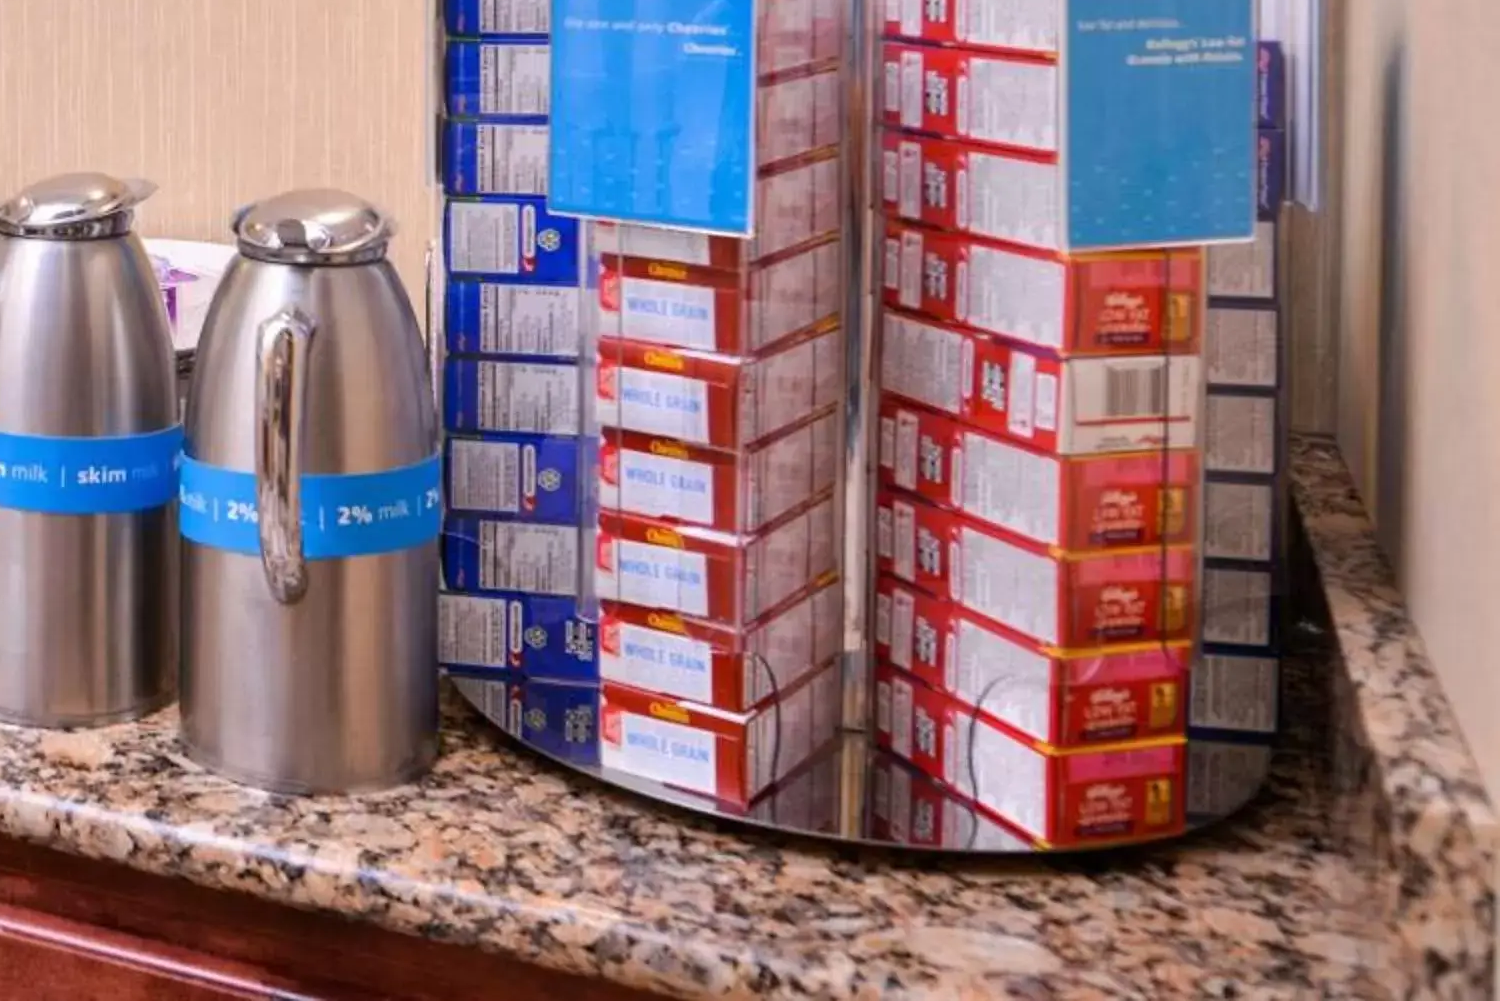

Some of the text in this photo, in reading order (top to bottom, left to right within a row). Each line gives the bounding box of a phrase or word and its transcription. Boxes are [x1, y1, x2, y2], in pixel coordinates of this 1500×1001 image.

[11, 462, 48, 484] milk
[77, 464, 127, 485] skim
[227, 500, 258, 524] 2%
[336, 505, 373, 526] 2%
[377, 499, 410, 520] milk
